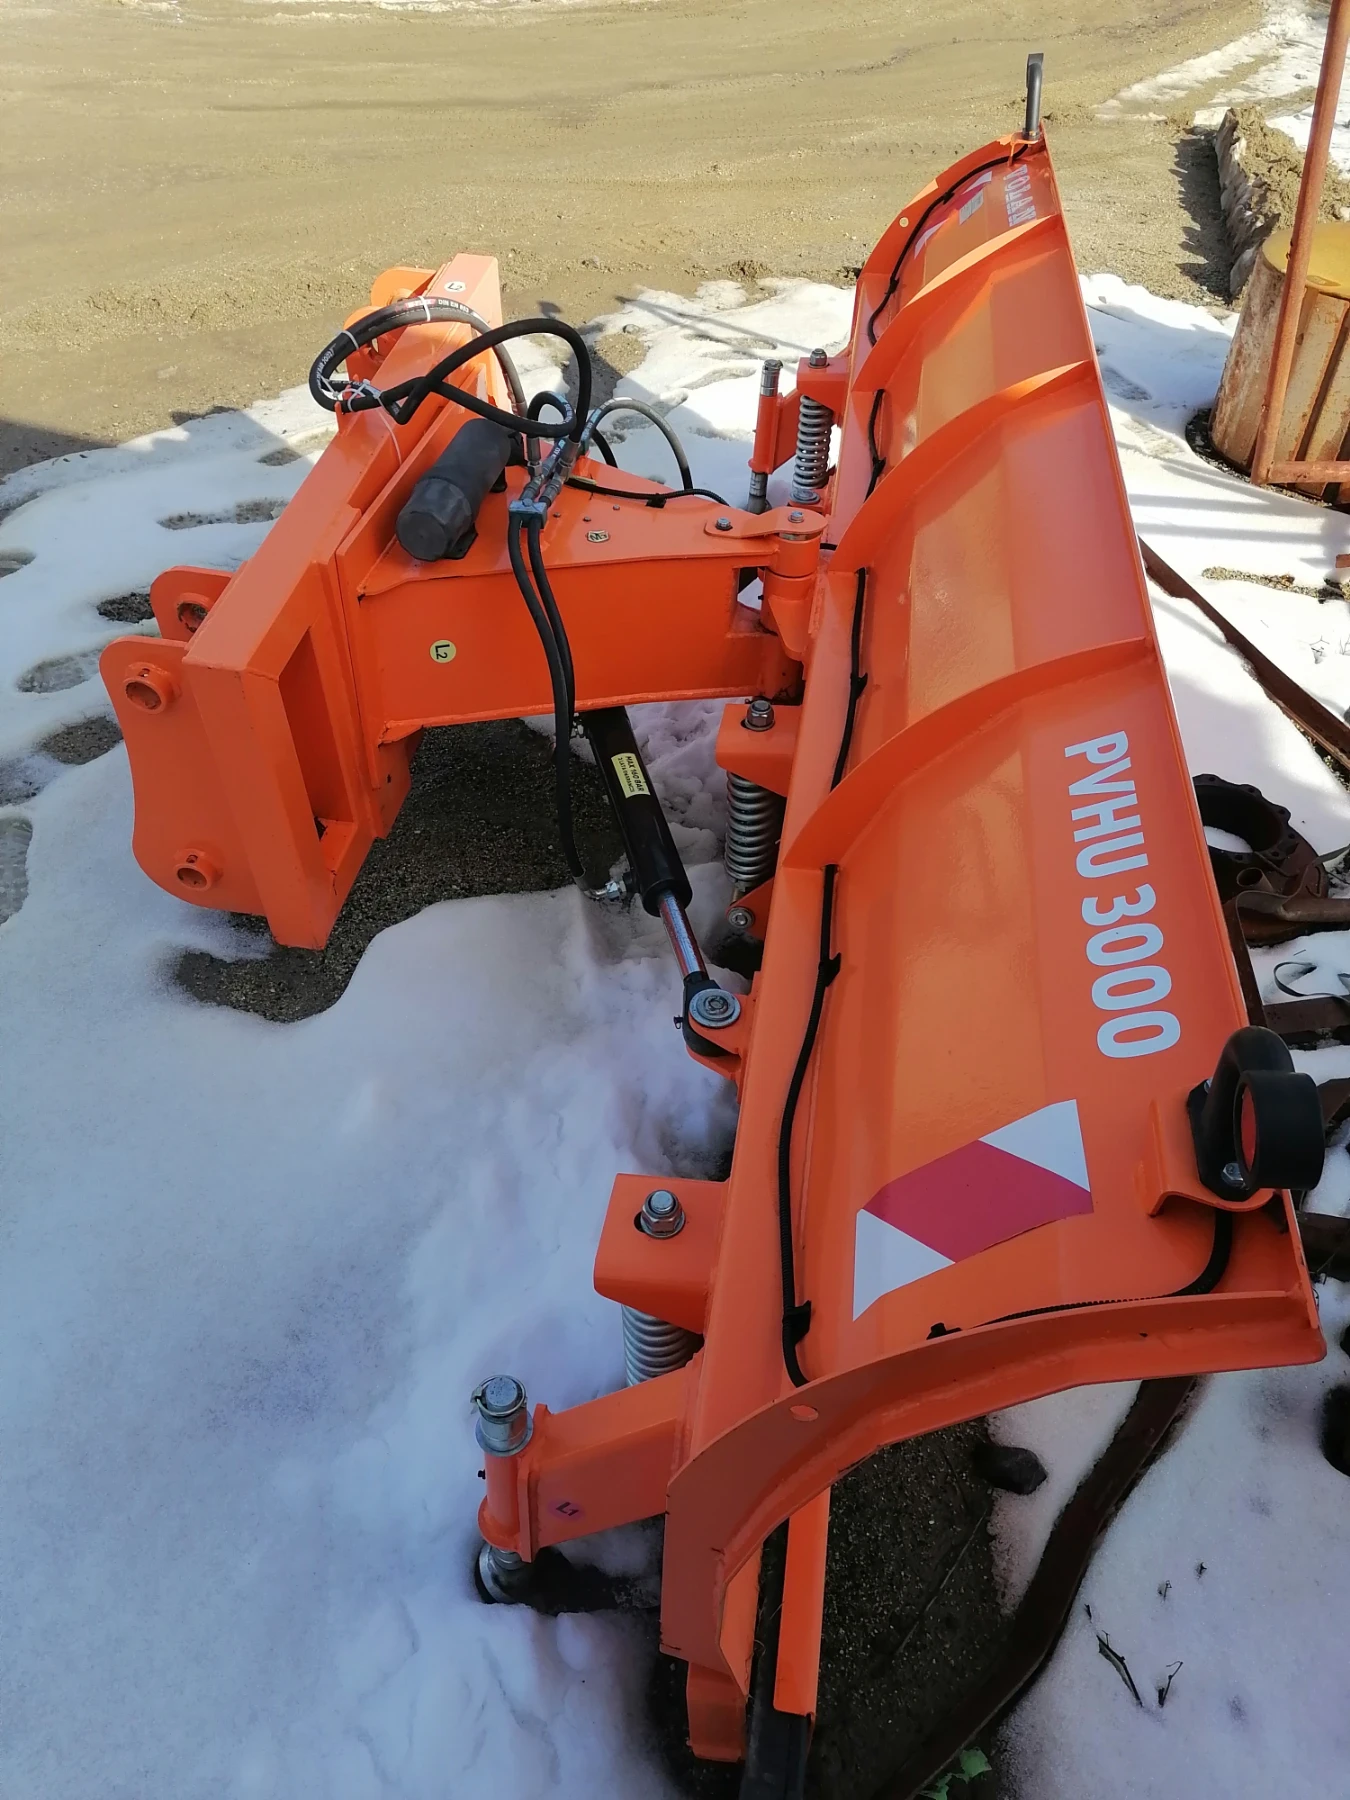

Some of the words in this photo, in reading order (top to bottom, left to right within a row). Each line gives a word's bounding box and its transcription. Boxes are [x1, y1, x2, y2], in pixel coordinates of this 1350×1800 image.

[434, 644, 450, 660] L2
[635, 780, 645, 791] BAR
[1064, 730, 1149, 878] PVHU
[1081, 883, 1181, 1059] 3000
[555, 1501, 579, 1516] L1
